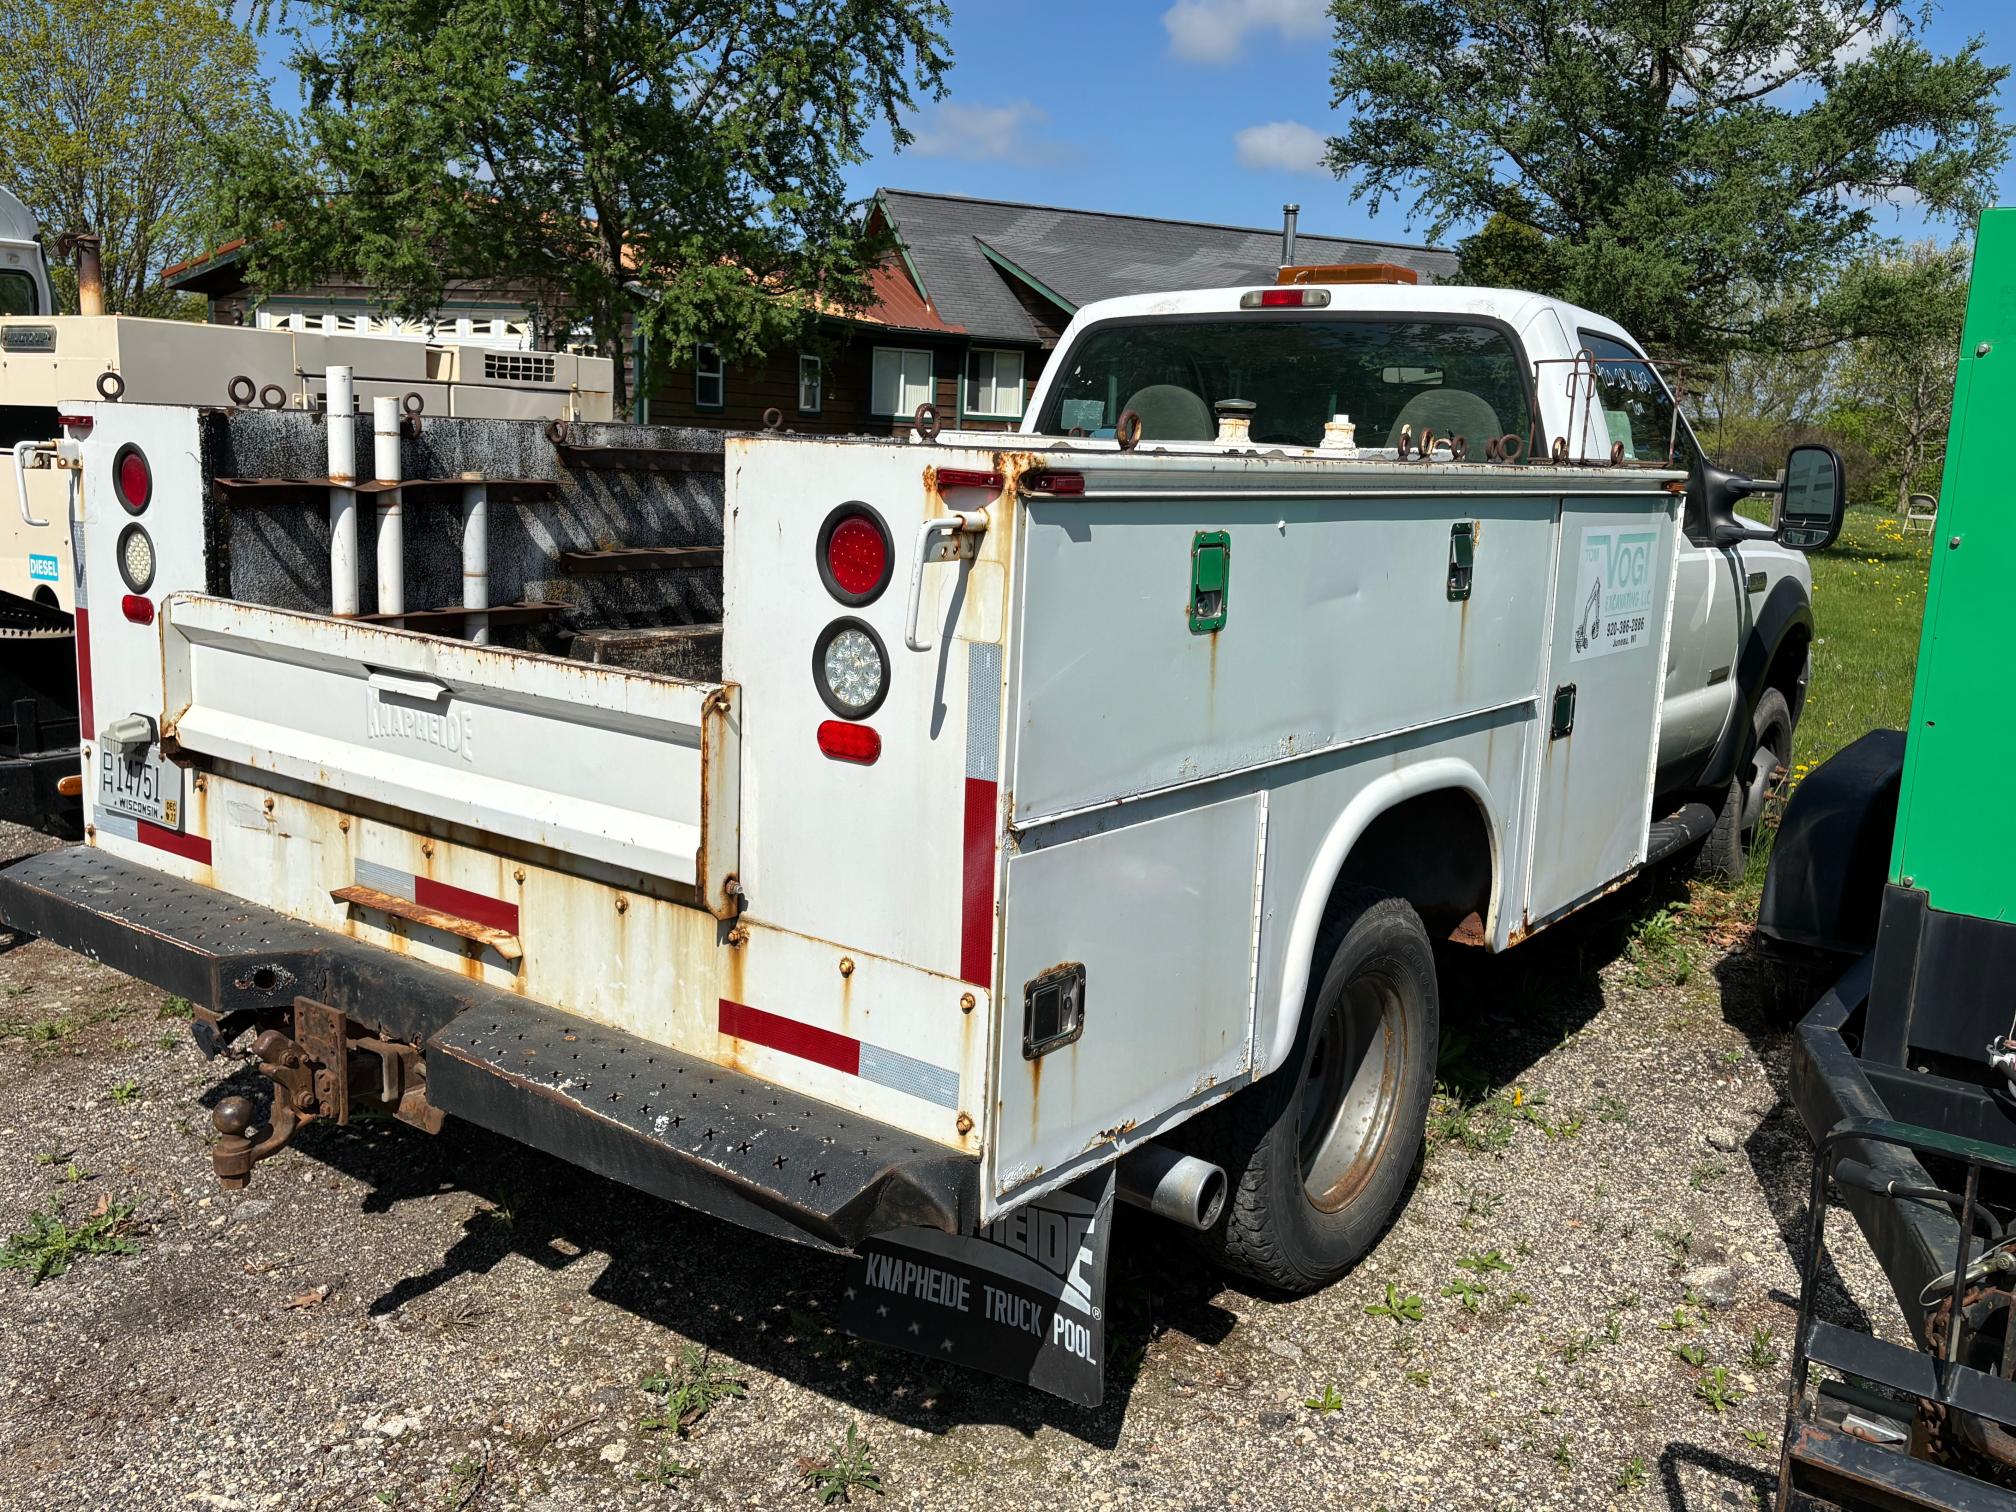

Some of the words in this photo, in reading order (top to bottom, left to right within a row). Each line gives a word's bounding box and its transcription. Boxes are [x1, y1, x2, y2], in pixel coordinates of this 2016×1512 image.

[30, 558, 58, 577] DIESEL
[1588, 532, 1657, 589] VOGT
[116, 756, 160, 803] 14751
[119, 798, 158, 818] WISCONSIN
[166, 801, 176, 812] DEC
[865, 1252, 971, 1312] KNAPHEIDE
[983, 1285, 1042, 1337] TRUCK
[1053, 1313, 1097, 1365] POOL
